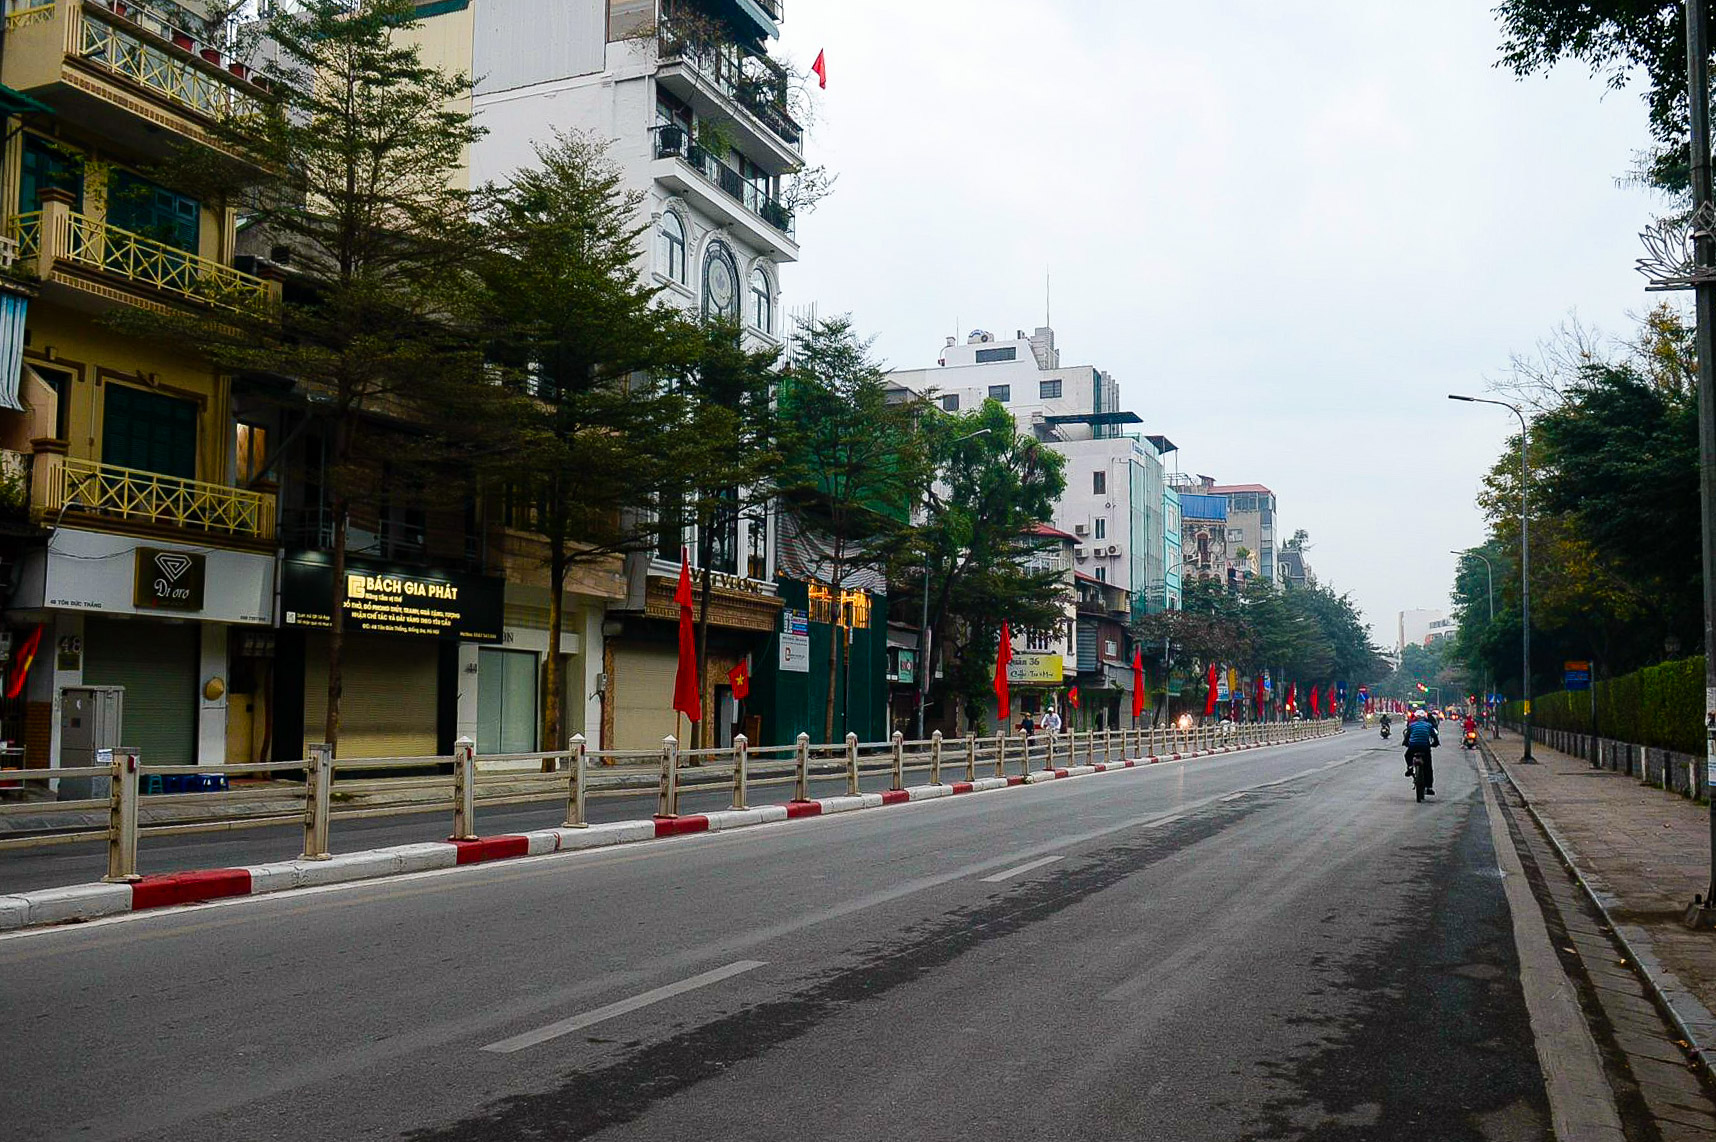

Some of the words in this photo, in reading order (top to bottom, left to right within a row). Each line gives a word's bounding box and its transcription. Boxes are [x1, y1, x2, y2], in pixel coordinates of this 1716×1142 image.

[172, 588, 190, 599] oro
[366, 575, 402, 594] BÁCH
[404, 581, 426, 596] GIA
[428, 584, 458, 600] PHÁT
